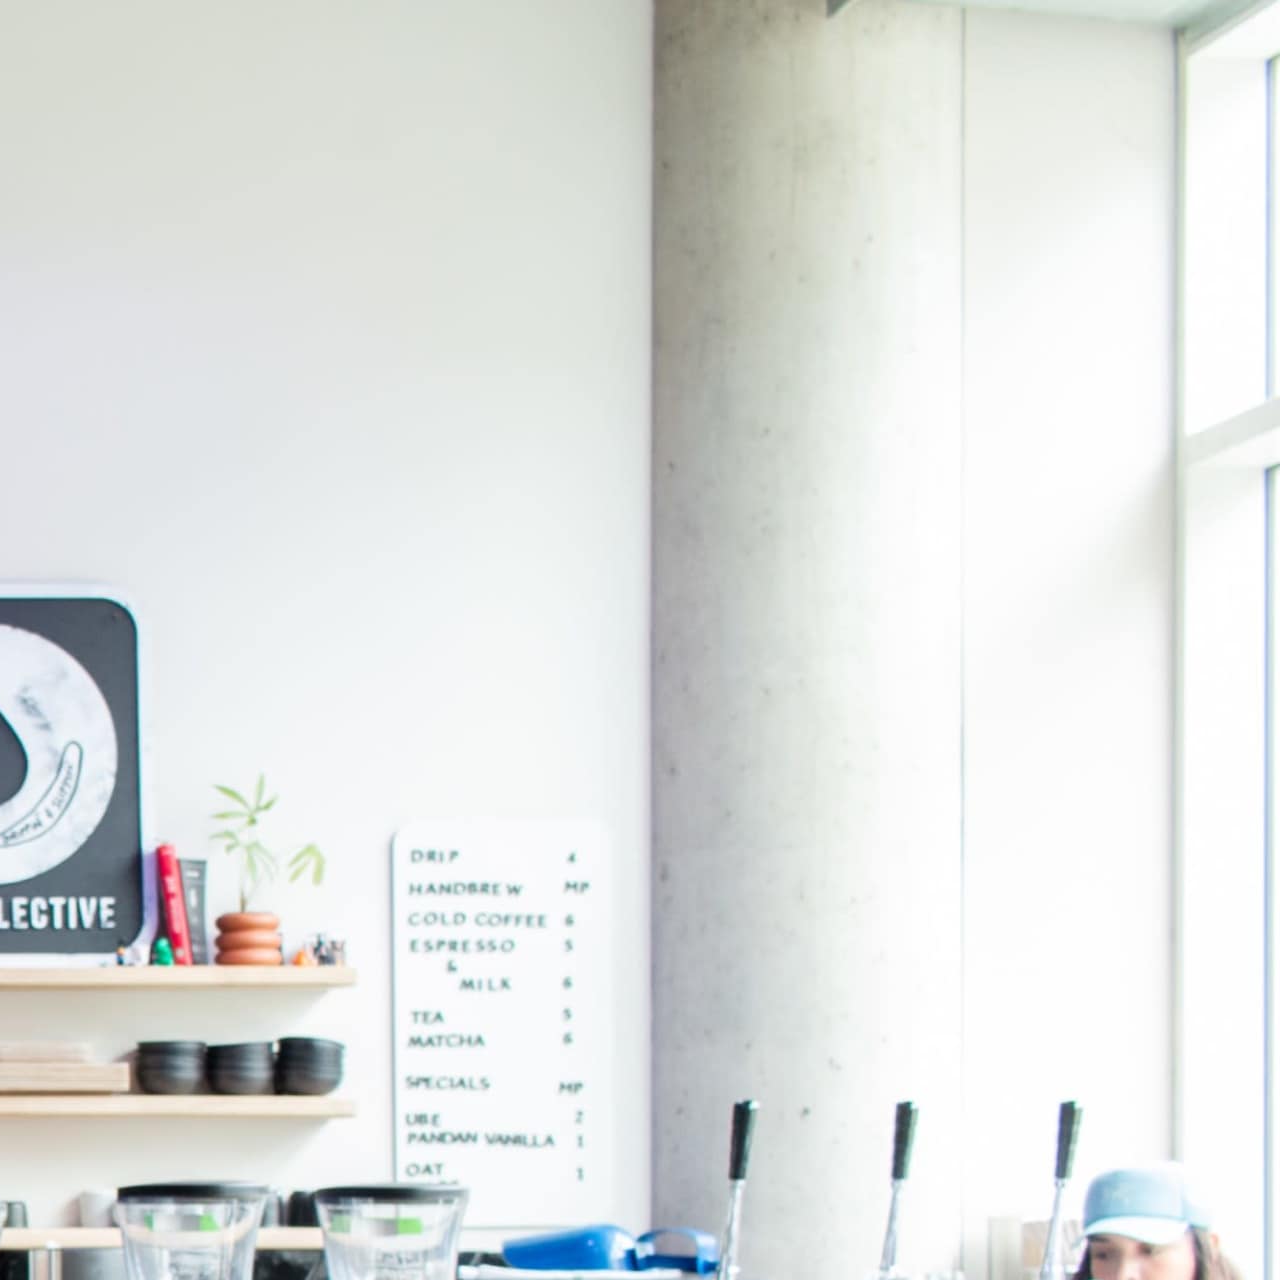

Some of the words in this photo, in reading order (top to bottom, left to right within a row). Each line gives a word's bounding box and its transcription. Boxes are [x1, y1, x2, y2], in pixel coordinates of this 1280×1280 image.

[410, 849, 460, 864] DRIP
[567, 852, 576, 864] 4
[409, 881, 523, 896] HANDBREW
[564, 880, 590, 894] MP
[408, 912, 467, 927] COLD
[474, 912, 546, 928] COFFEE
[409, 939, 516, 953] ESPRESSO
[564, 938, 573, 952] 5
[459, 977, 511, 992] MILK
[411, 1010, 444, 1025] TEA
[563, 1008, 573, 1021] 5
[408, 1034, 485, 1048] MATCHA
[405, 1075, 491, 1090] SPECIALS
[559, 1081, 584, 1094] MP
[405, 1112, 440, 1128] UBE
[575, 1110, 584, 1124] 2
[408, 1131, 478, 1144] PANDAN
[484, 1133, 555, 1148] VANILLA
[405, 1163, 444, 1178] OAT
